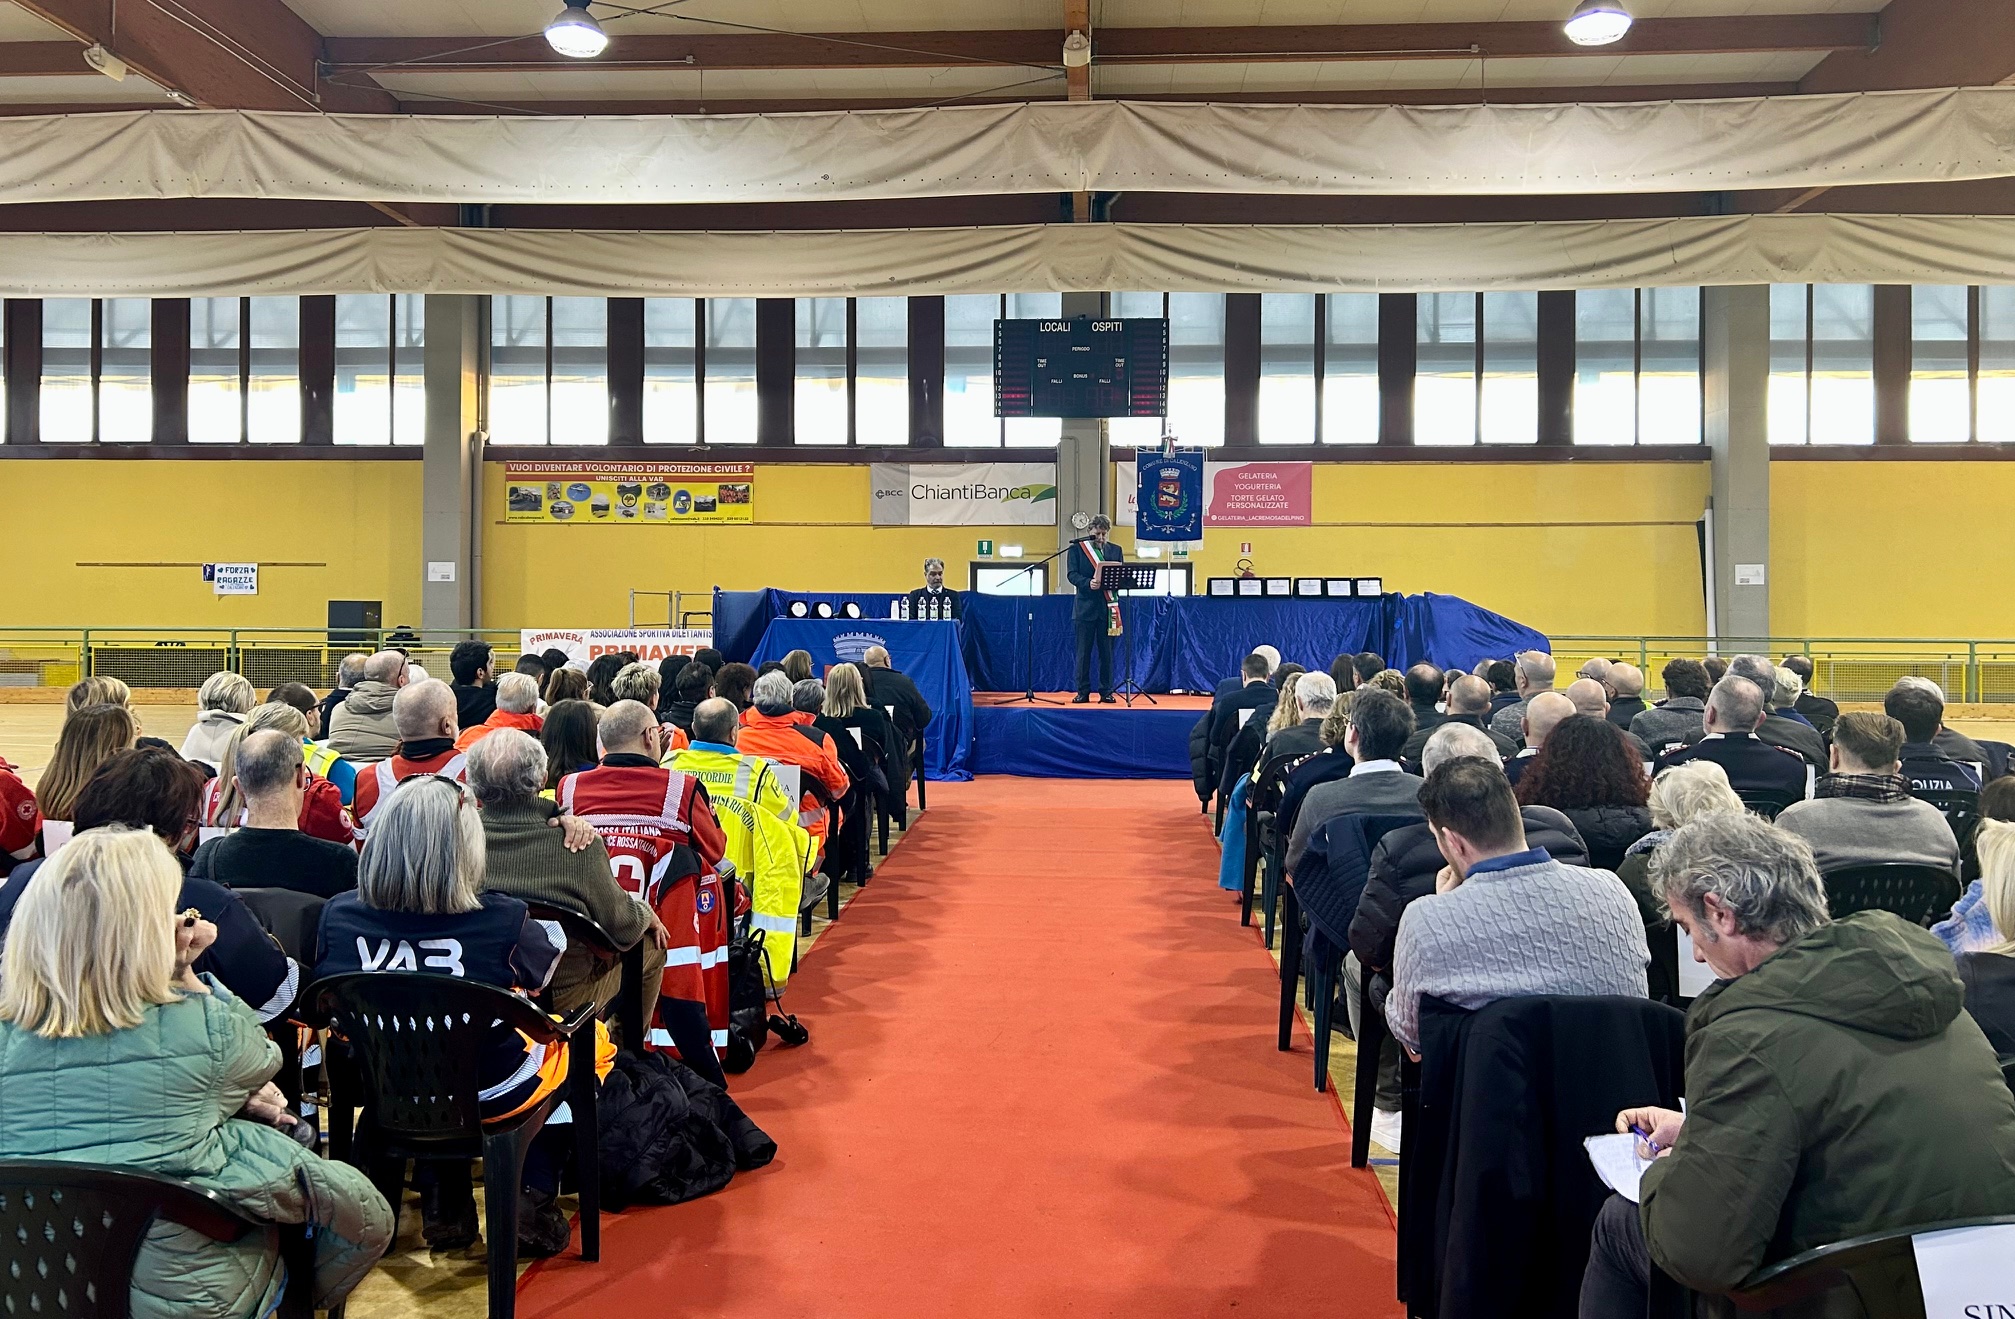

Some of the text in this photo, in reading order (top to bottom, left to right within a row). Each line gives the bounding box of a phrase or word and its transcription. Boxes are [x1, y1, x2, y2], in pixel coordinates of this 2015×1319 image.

[1039, 321, 1123, 332] LOCALI OSPITI
[509, 463, 751, 473] VUOI DIVENTARE VOLONTARIO DI PROTEZIONE CIVILE ?
[1238, 472, 1278, 480] GELATERIA
[885, 489, 904, 498] BCC
[911, 484, 1031, 500] ChiantiBanca
[1226, 501, 1289, 509] PERSONALIZZATE
[225, 566, 250, 574] FORZA
[216, 576, 254, 584] RAGAZZE
[590, 629, 638, 638] ASSOCIAZIONE
[638, 629, 671, 638] SPORTIVA
[529, 632, 584, 646] PRIMAVERA
[1911, 779, 1954, 790] OLIZIA
[616, 835, 639, 850] ROSSA
